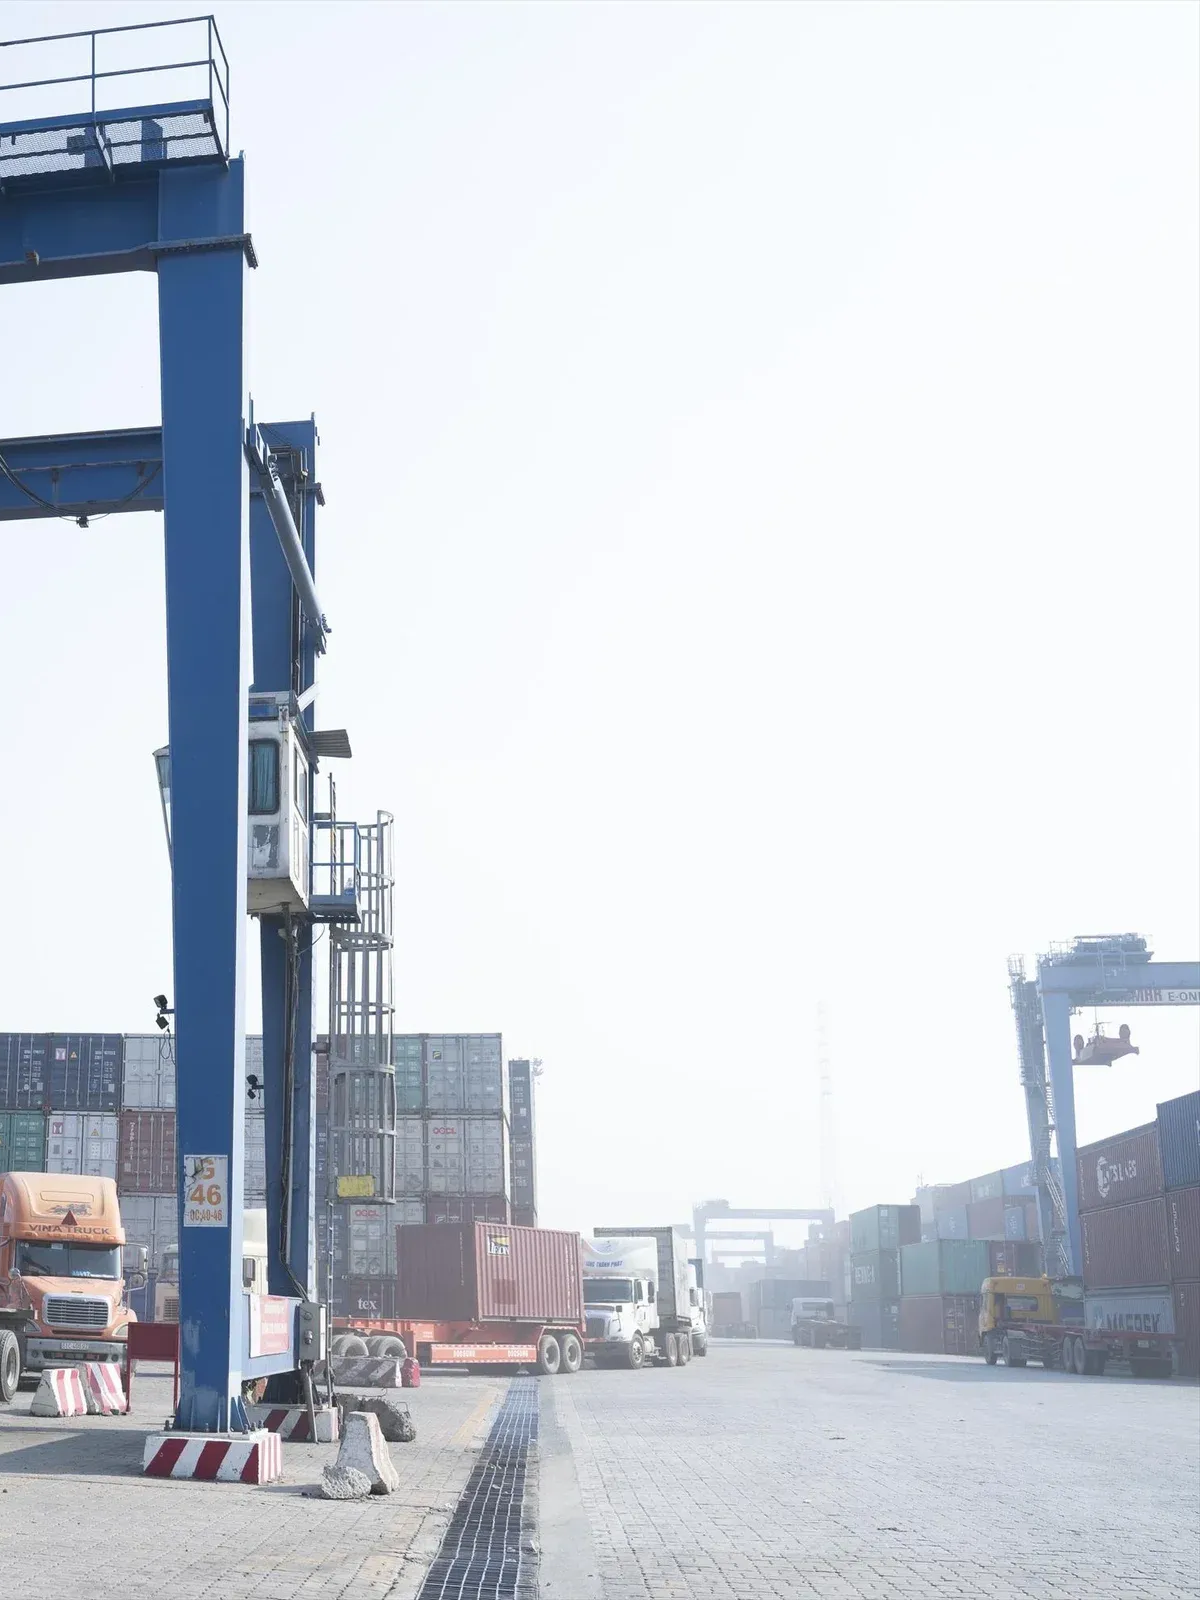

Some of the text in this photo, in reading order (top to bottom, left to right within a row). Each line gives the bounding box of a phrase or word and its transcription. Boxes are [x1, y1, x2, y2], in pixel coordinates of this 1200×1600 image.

[190, 1184, 222, 1206] 46
[29, 1224, 111, 1235] VINA TRUCK
[357, 1297, 377, 1310] tex
